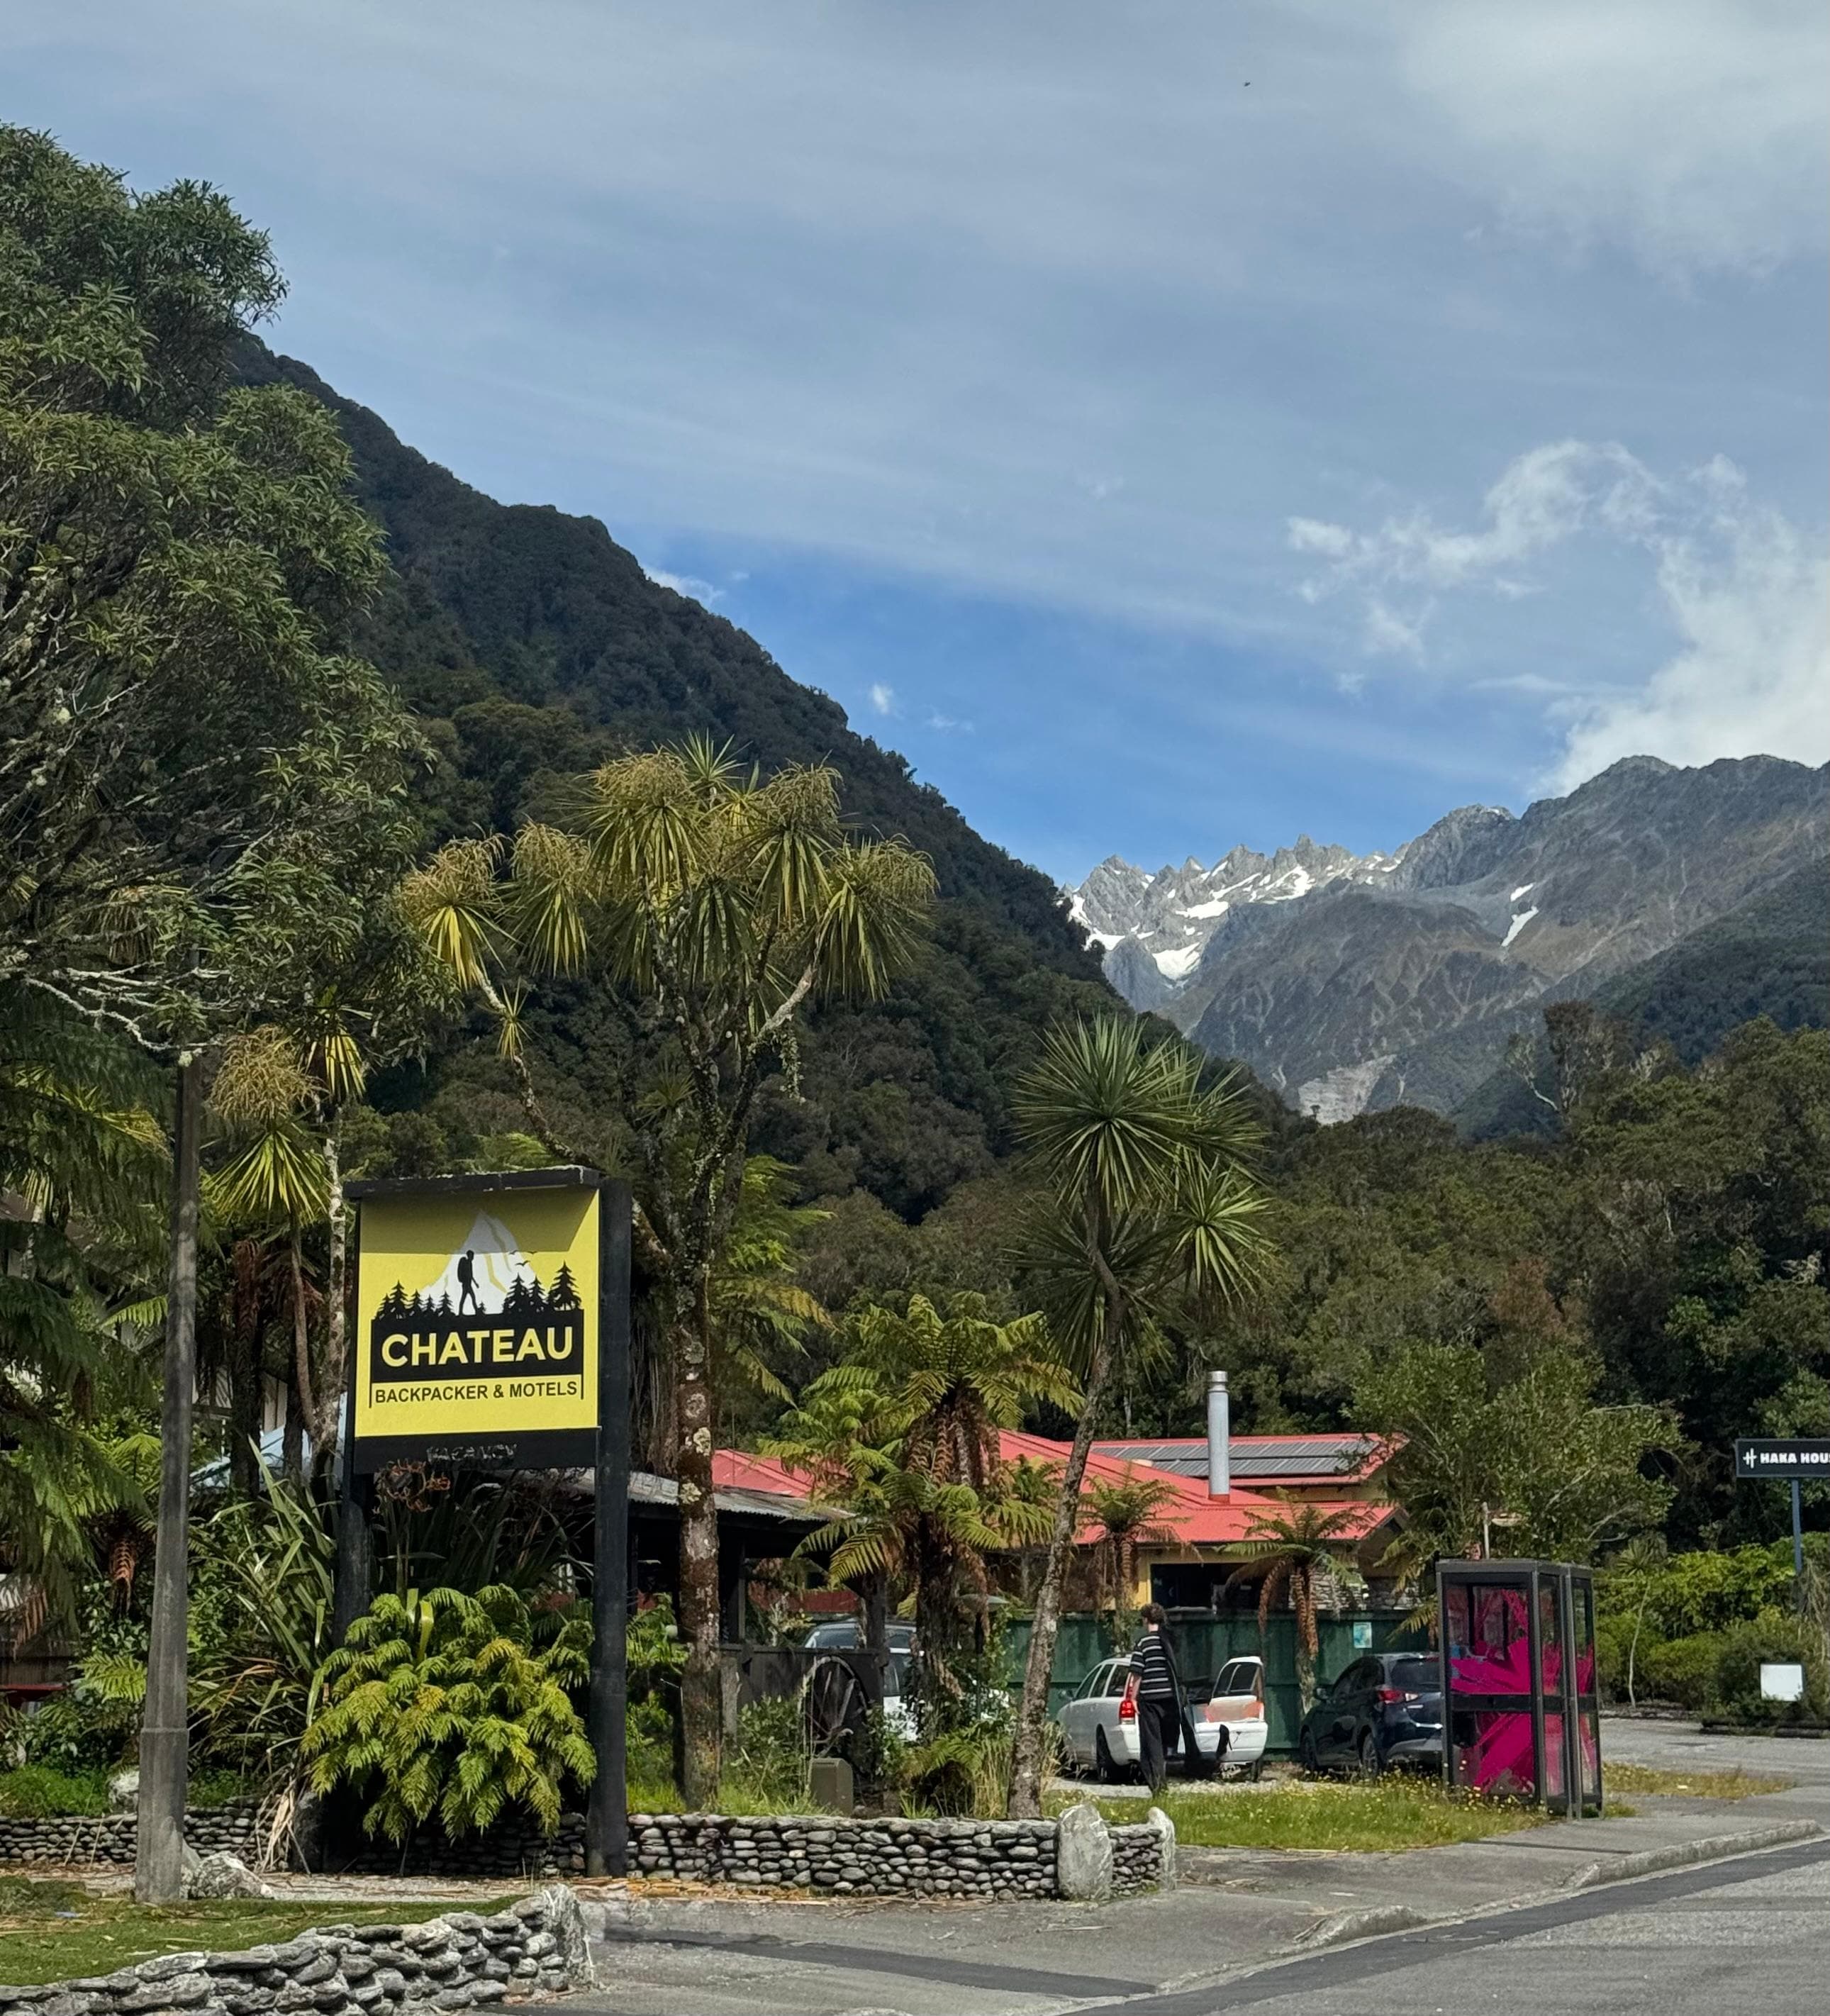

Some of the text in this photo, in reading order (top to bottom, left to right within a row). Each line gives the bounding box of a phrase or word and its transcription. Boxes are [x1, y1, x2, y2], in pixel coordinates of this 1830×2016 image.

[381, 1326, 573, 1367] CHATEAU
[375, 1381, 577, 1403] BACKPACKER & MOTELS
[1760, 1452, 1830, 1464] HAKA HOU
